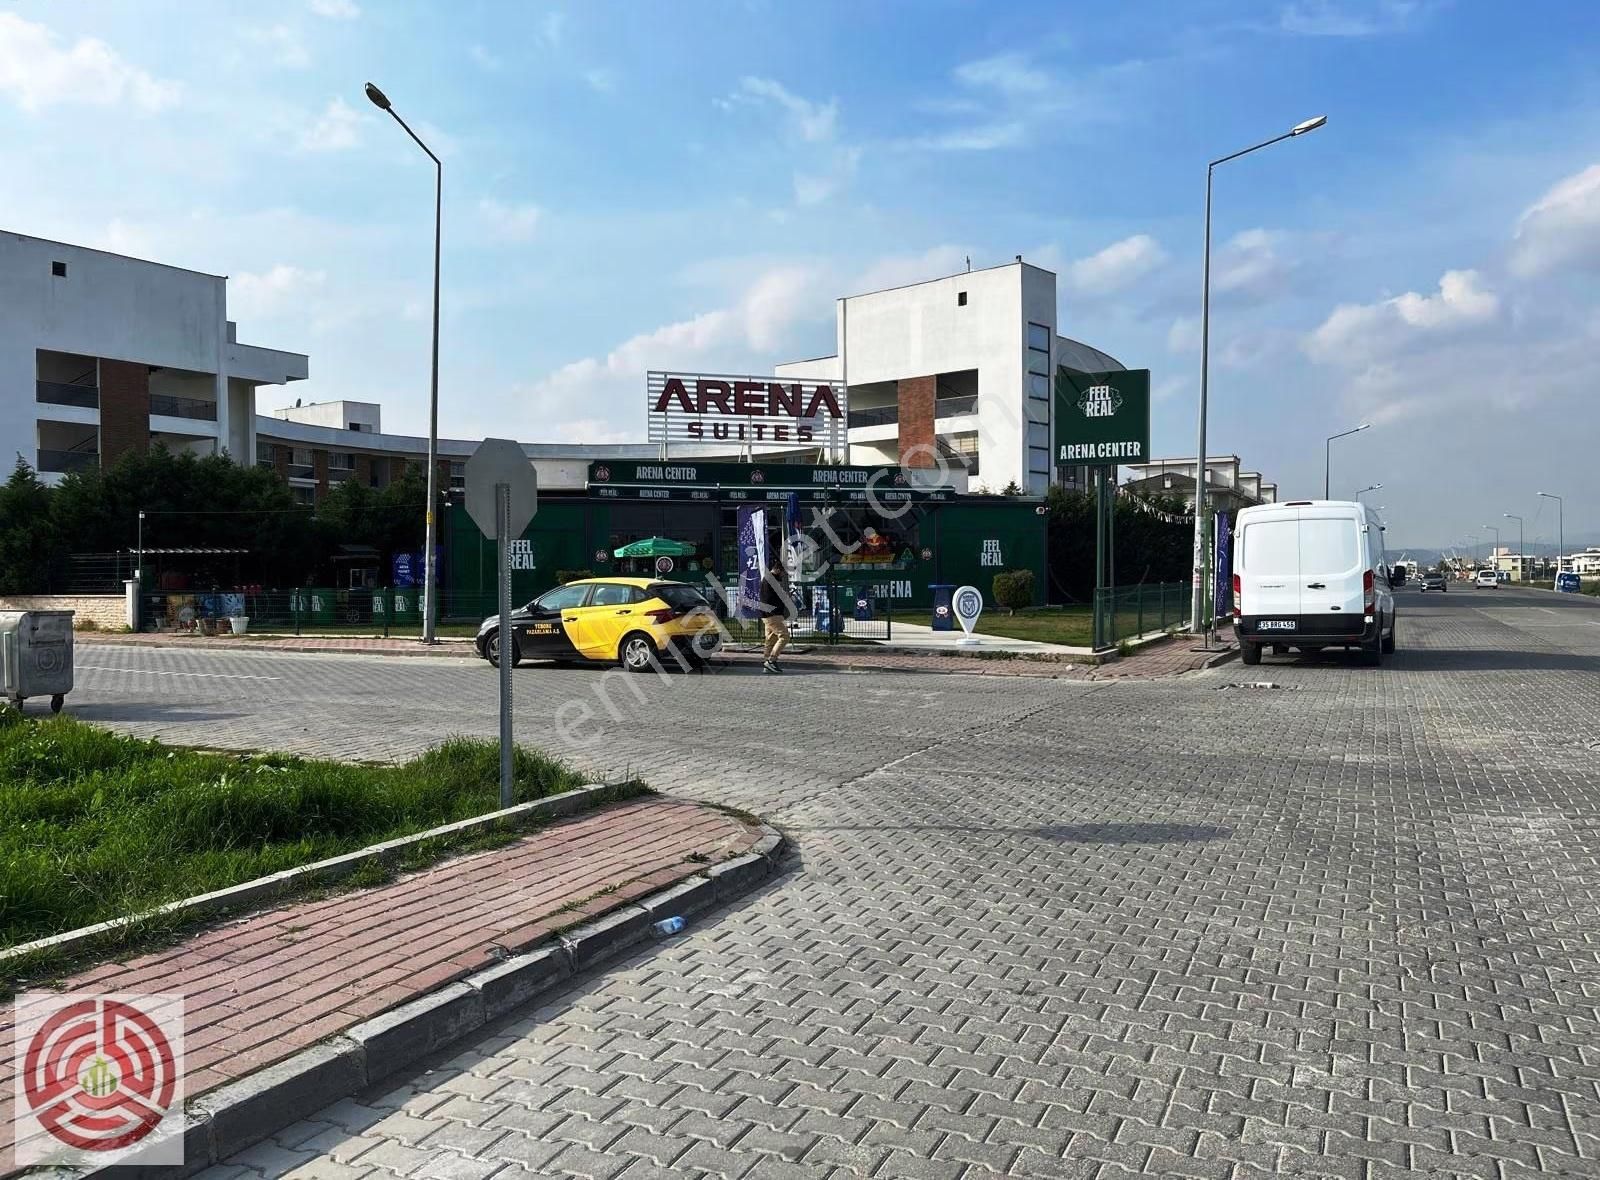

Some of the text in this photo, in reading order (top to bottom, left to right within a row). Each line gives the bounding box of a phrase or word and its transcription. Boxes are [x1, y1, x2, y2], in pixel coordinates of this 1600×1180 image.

[653, 378, 844, 418] ARENA
[1089, 385, 1111, 401] FEEL
[1086, 400, 1114, 417] REAL
[687, 421, 813, 442] SUITES
[1060, 441, 1141, 460] ARENA CENTER
[636, 466, 697, 480] ARENA CENTER
[812, 470, 868, 483] ARENA CENTER
[653, 490, 670, 498] CENTER
[511, 540, 533, 553] FEEL
[983, 540, 1001, 553] FEEL
[981, 552, 1004, 567] REAL
